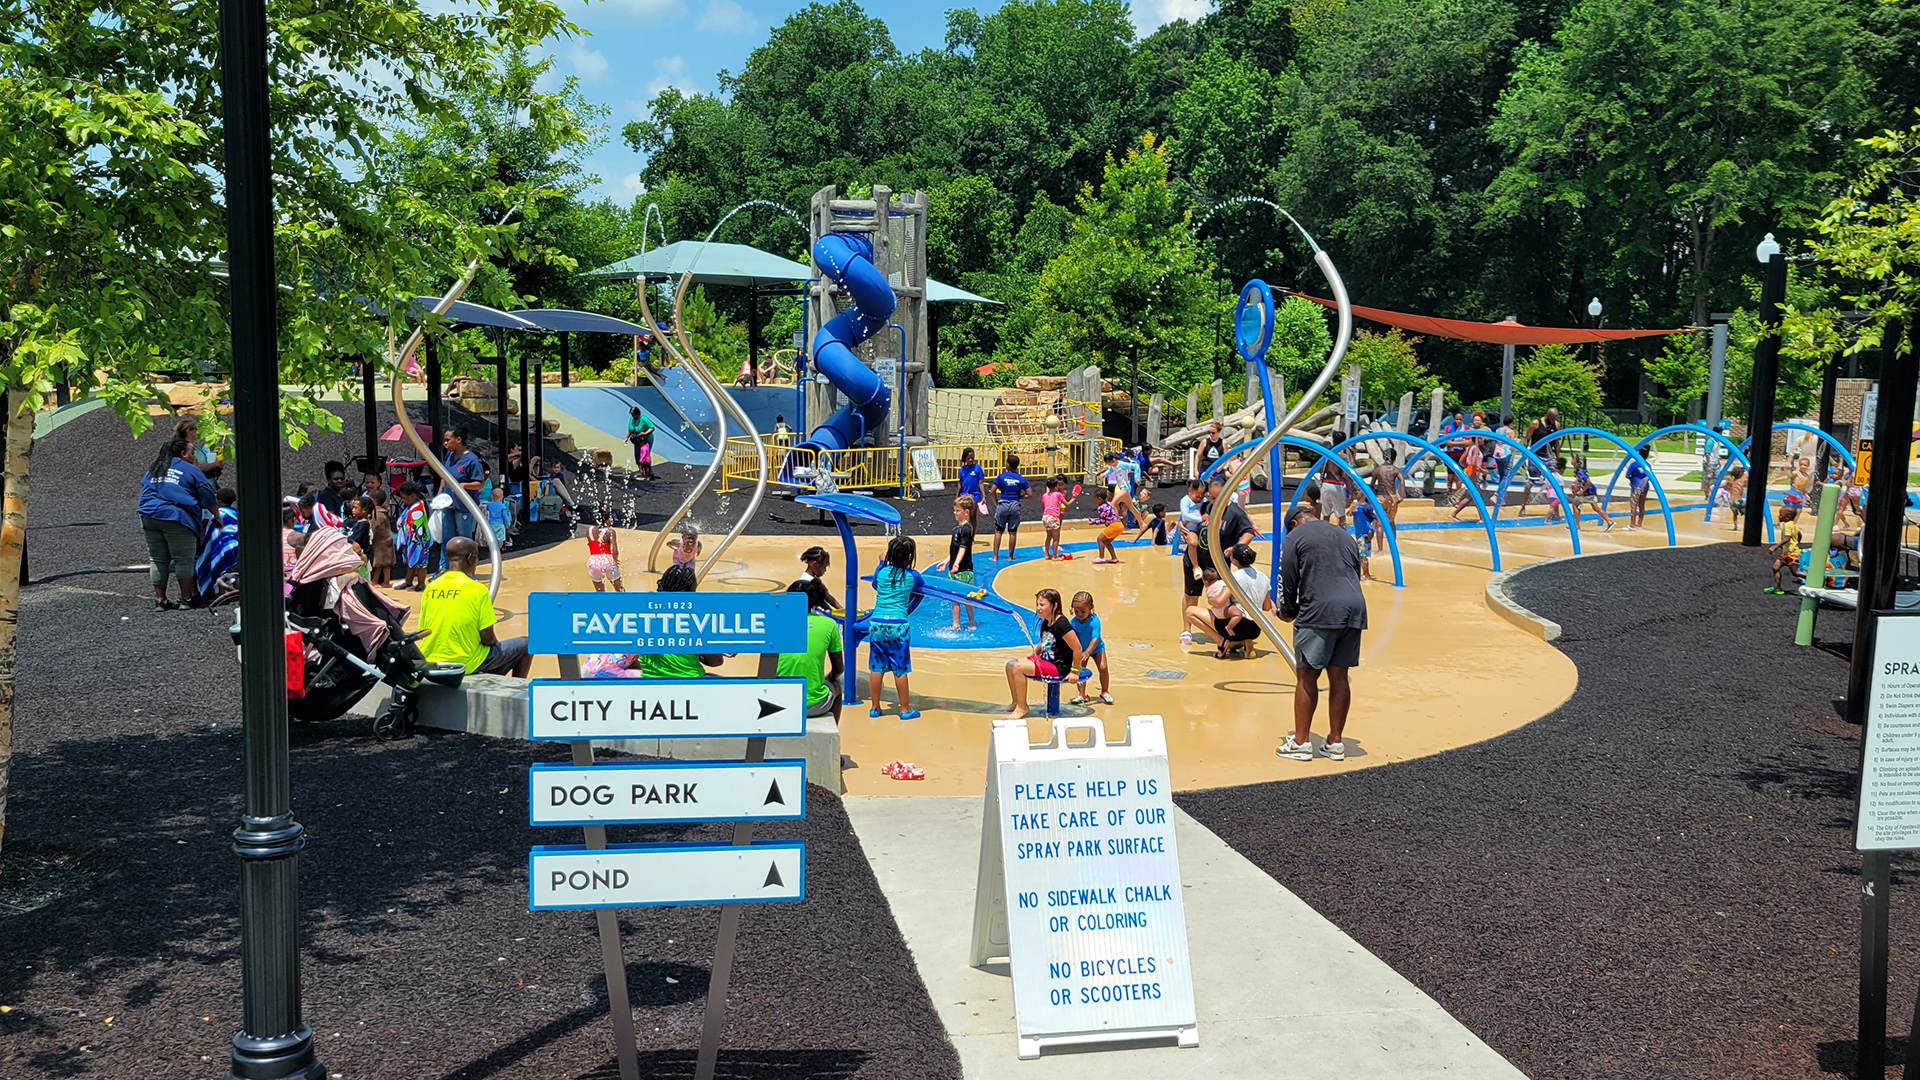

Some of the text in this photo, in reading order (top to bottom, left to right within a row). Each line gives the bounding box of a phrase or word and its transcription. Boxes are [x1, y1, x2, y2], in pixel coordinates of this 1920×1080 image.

[425, 589, 462, 600] STAFF
[667, 602, 693, 610] 1823
[572, 613, 766, 635] FAYETTEVILLE
[637, 638, 703, 647] GEORGIA
[1884, 662, 1920, 675] SPRA
[550, 700, 699, 722] CITY HALL
[551, 783, 699, 807] DOG PARK
[1015, 779, 1158, 800] PLEASE HELP US
[1011, 808, 1166, 830] TAKE CARE OF OUR
[1018, 836, 1165, 859] SPRAY PARK SURFACE
[551, 869, 630, 891] POND
[1019, 885, 1172, 908] NO SIDEWALK CHALK
[1050, 911, 1147, 932] OR COLORING
[1050, 957, 1156, 979] NO BICYCLES
[1050, 982, 1161, 1006] OR SCOOTERS
